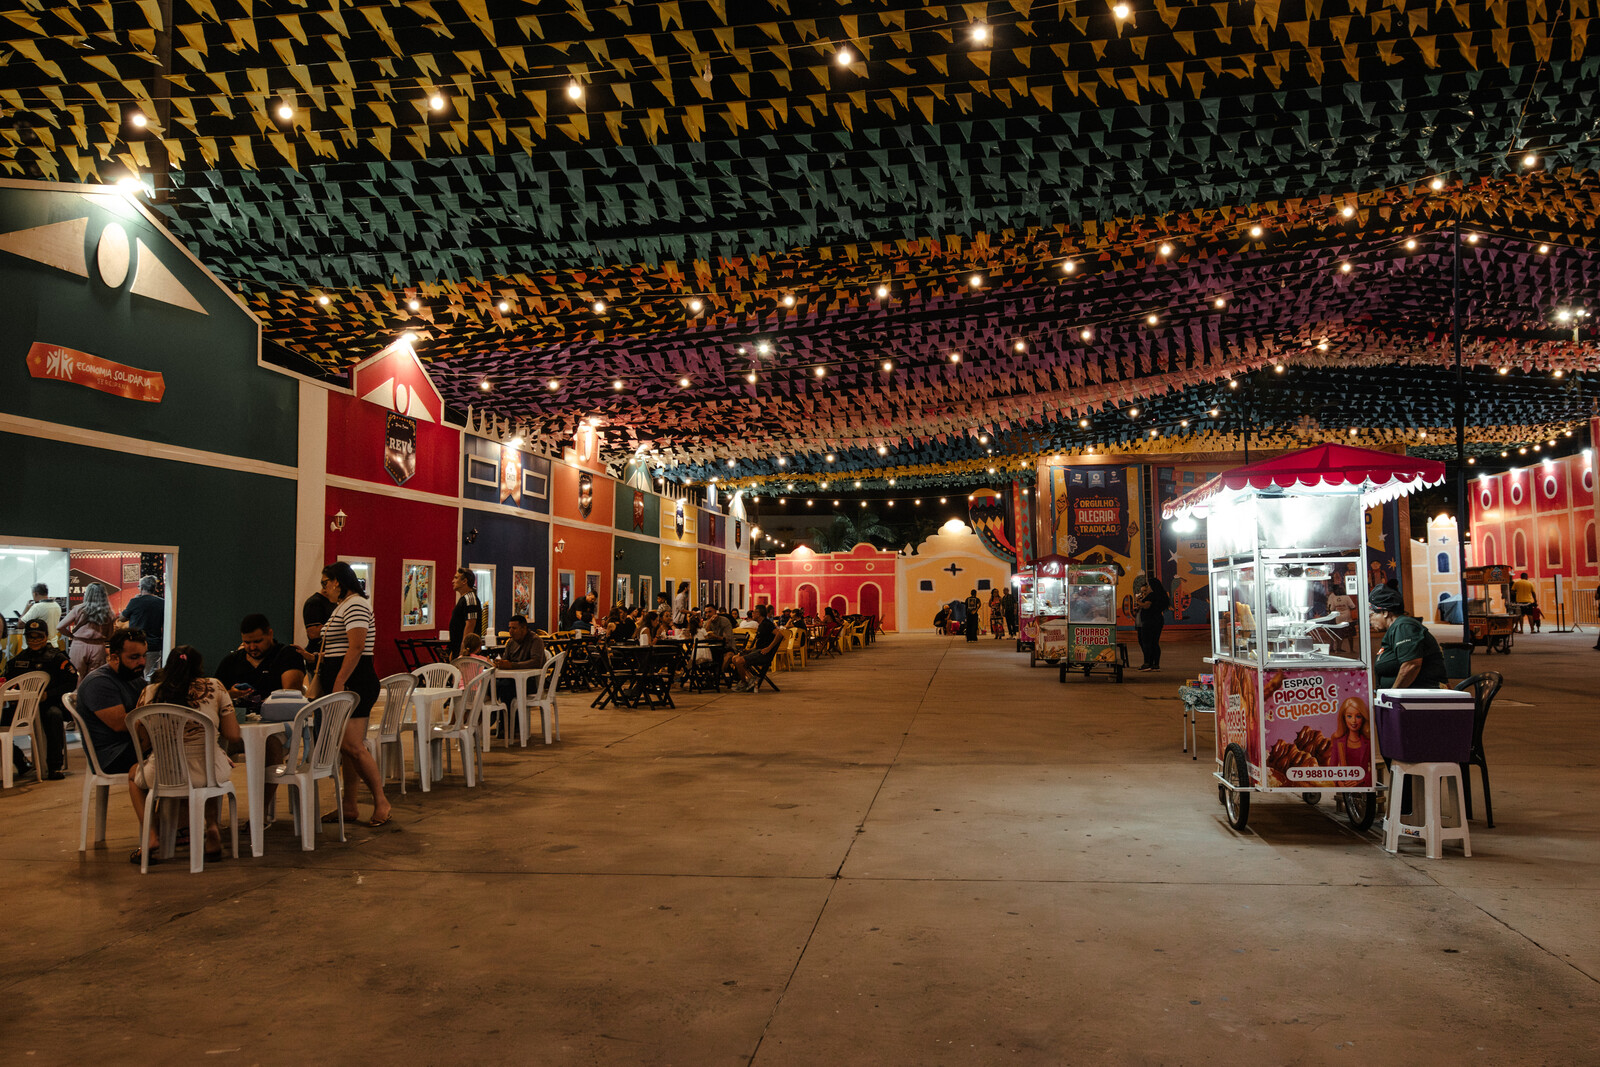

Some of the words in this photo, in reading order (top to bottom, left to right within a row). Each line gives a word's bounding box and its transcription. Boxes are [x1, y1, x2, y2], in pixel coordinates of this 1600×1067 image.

[76, 361, 112, 379] ECONOMIA
[113, 370, 151, 389] SOLIDÁRIA
[1080, 499, 1114, 508] ORGULHO
[1079, 510, 1114, 523] ALEGRIA
[1190, 542, 1206, 550] PELO
[1075, 627, 1110, 637] CHURROS
[1075, 636, 1081, 645] E
[1082, 636, 1110, 646] PIPOCA
[1284, 676, 1323, 689] ESPAÇO
[1274, 686, 1327, 703] PIPOCA
[1328, 685, 1337, 697] E
[1276, 701, 1338, 720] CHURROS
[1291, 769, 1303, 779] 79
[1305, 769, 1360, 779] 98810-6149
